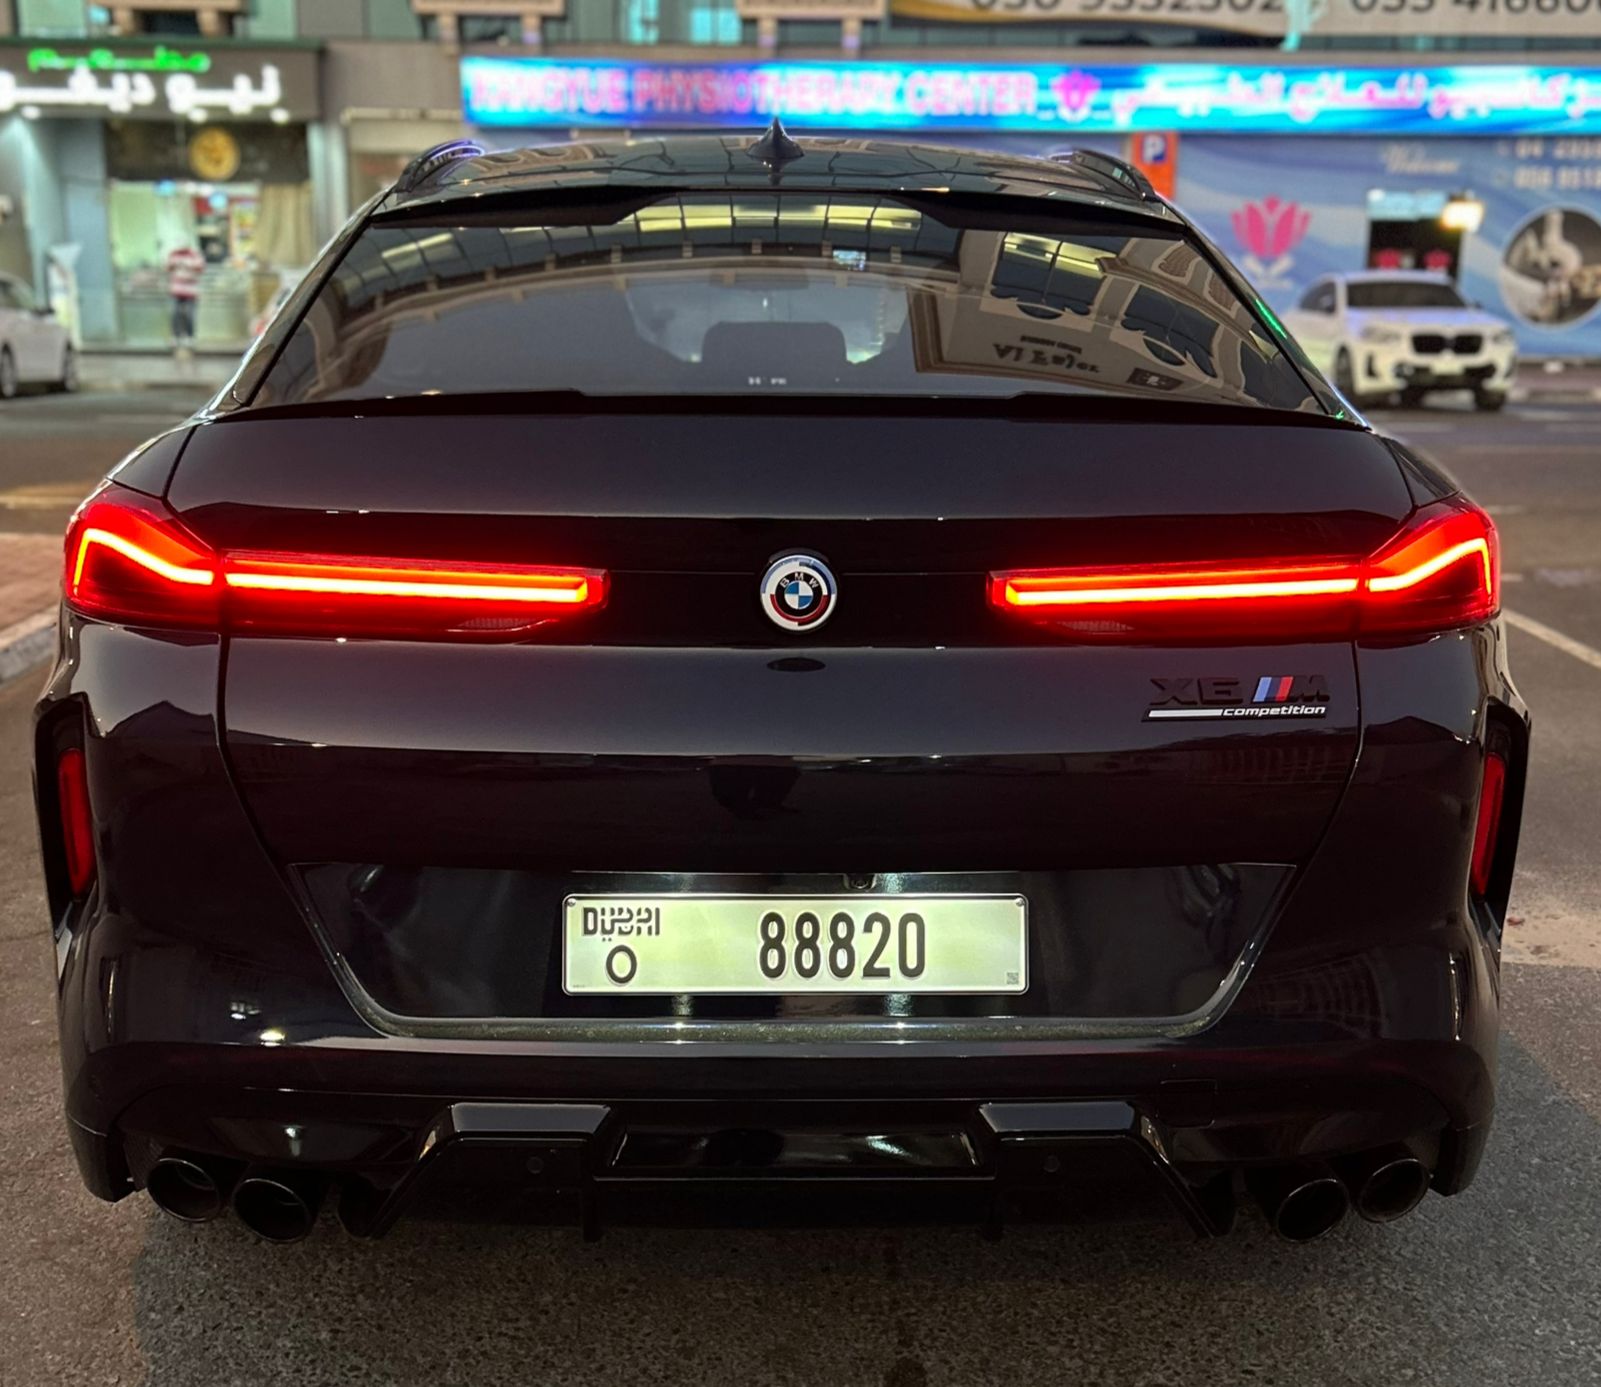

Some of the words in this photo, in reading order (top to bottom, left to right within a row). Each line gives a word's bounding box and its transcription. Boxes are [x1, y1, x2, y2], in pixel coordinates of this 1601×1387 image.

[633, 67, 899, 115] PHYSIOTHERAPY
[904, 70, 1038, 116] CENTER
[1143, 136, 1165, 164] P
[780, 572, 820, 589] BMW
[1150, 678, 1244, 705] X6
[1222, 704, 1327, 717] competition
[759, 911, 926, 979] 88820
